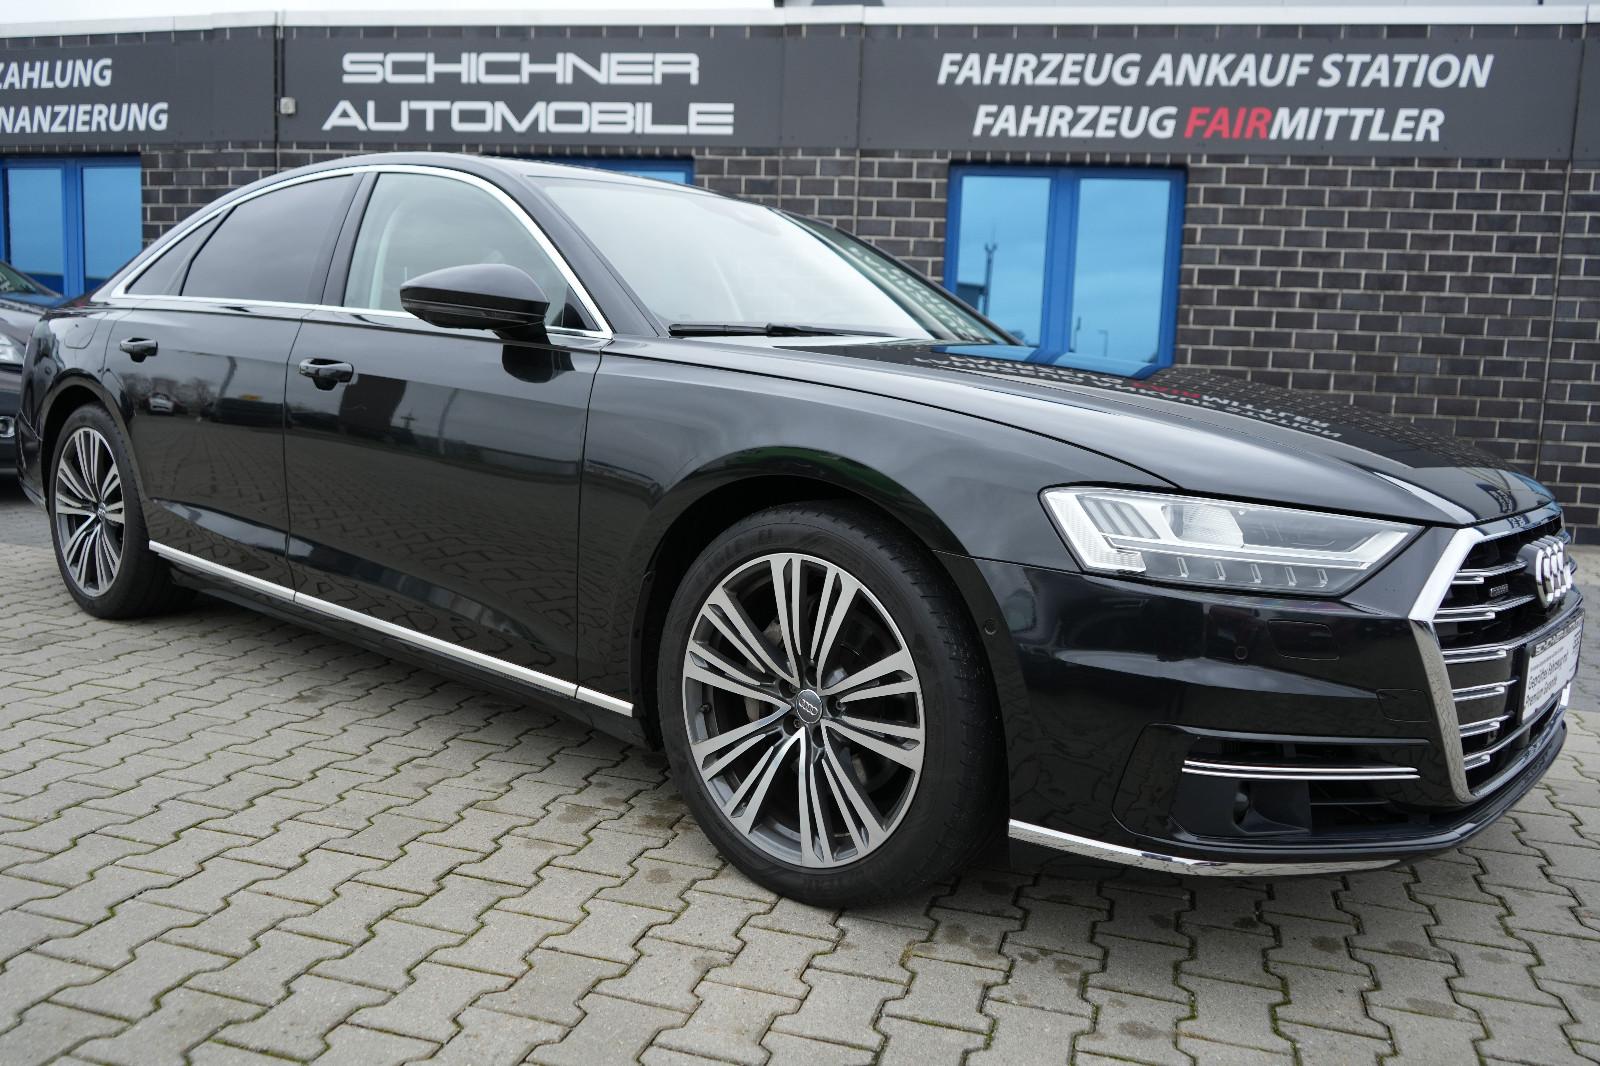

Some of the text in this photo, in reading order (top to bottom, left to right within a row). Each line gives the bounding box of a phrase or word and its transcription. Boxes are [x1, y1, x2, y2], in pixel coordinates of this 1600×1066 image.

[0, 57, 113, 90] AHLUNG
[341, 51, 700, 86] SCHICHNER
[936, 52, 1495, 89] FAHRZEUG ANKAUF STATION
[321, 99, 735, 136] AUTOMOBILE
[972, 104, 1446, 143] FAHRZEUG FAIRMITTLER
